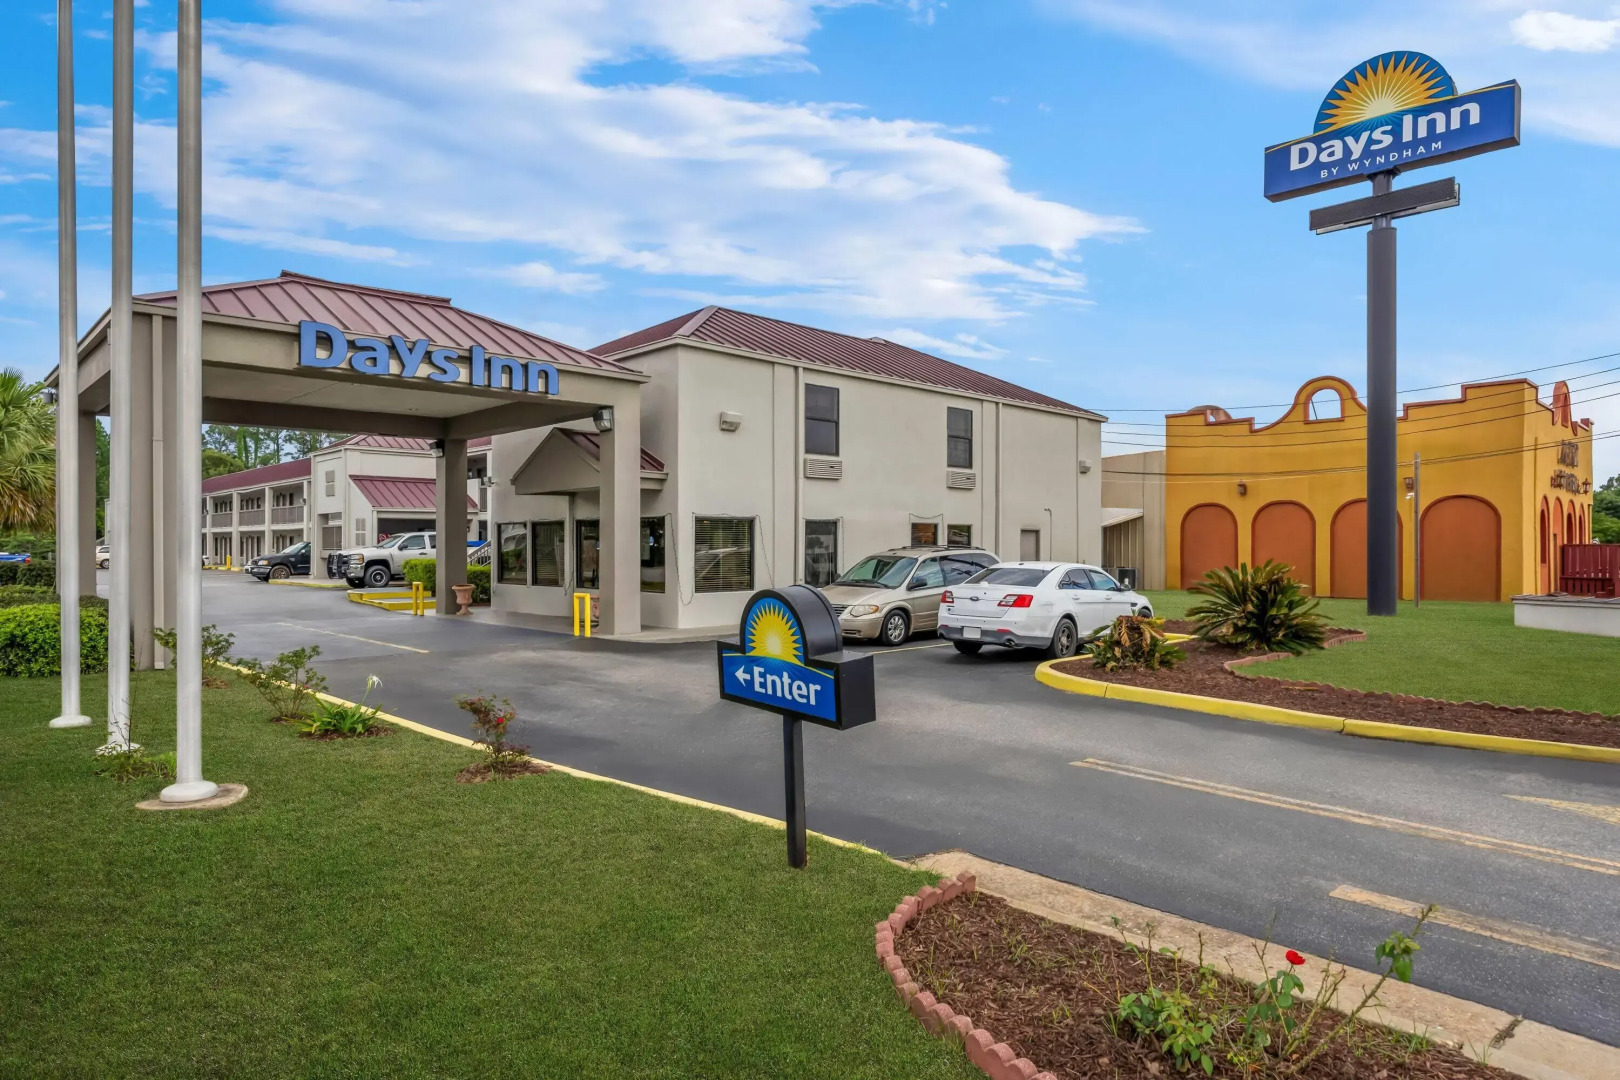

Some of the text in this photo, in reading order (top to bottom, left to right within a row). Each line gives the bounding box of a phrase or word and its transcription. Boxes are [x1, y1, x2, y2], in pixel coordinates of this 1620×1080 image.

[1289, 102, 1480, 171] Days Inn
[1320, 140, 1442, 178] BY WYNDHAM
[299, 320, 560, 396] Days Inn
[753, 665, 822, 706] Enter
